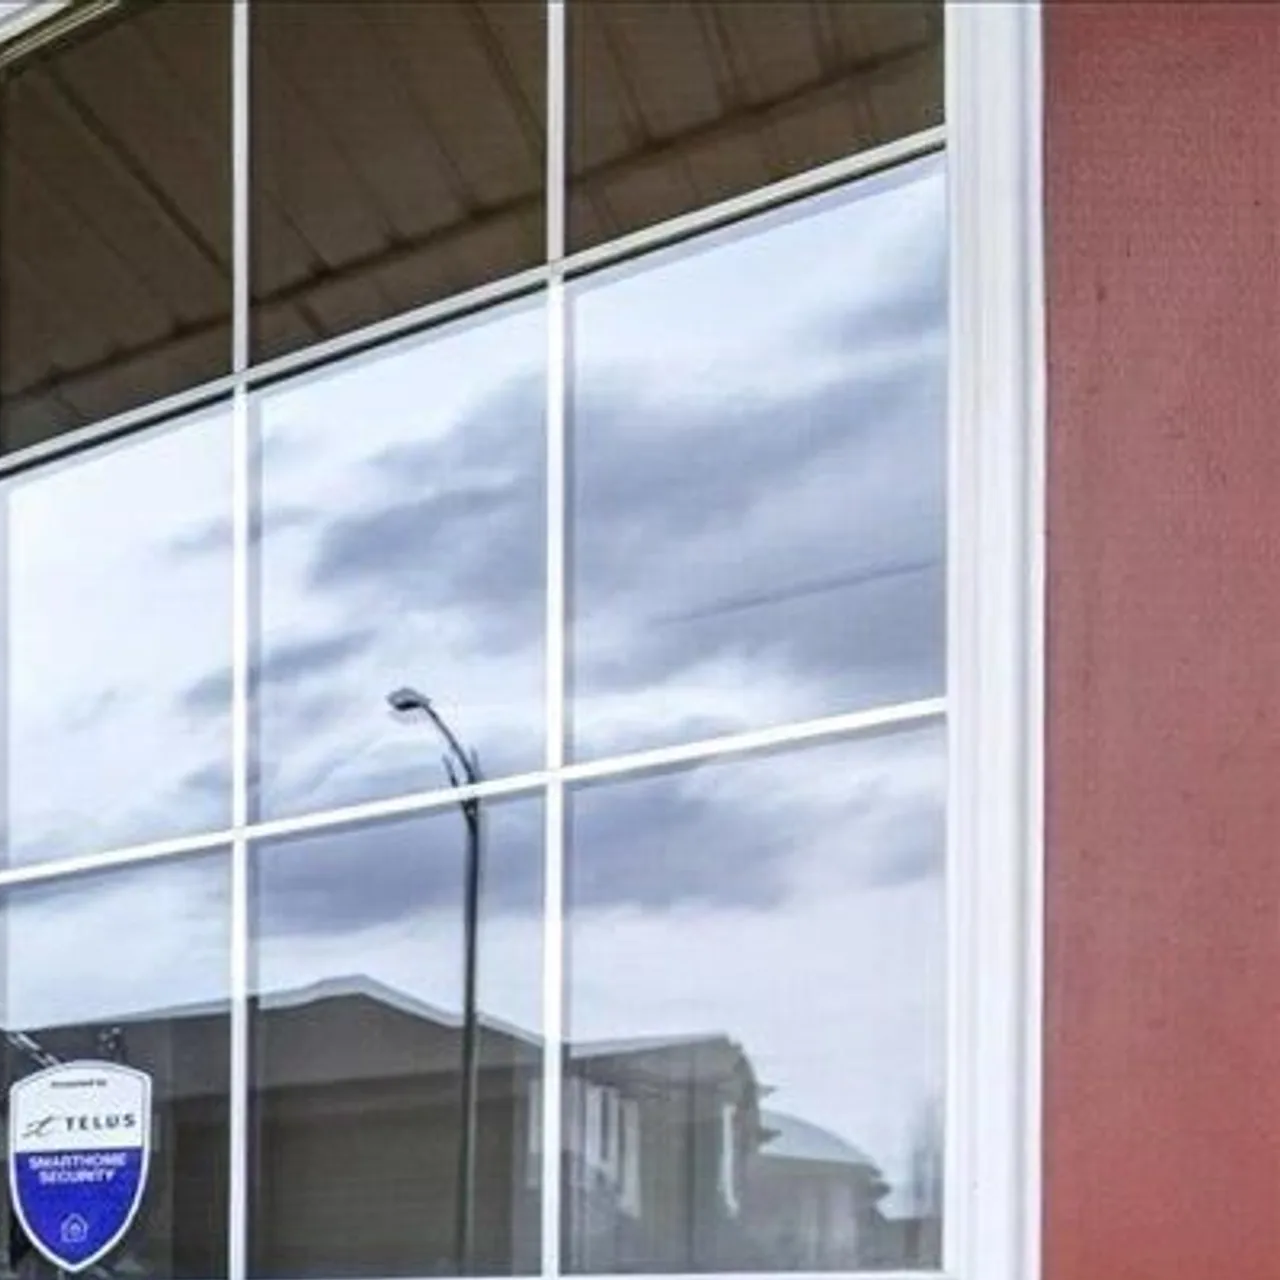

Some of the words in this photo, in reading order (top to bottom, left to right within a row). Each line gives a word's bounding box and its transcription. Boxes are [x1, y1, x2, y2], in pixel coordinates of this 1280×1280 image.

[65, 1113, 137, 1132] TELUS
[28, 1153, 128, 1171] SMARTHOME
[38, 1168, 116, 1186] SECURITY
